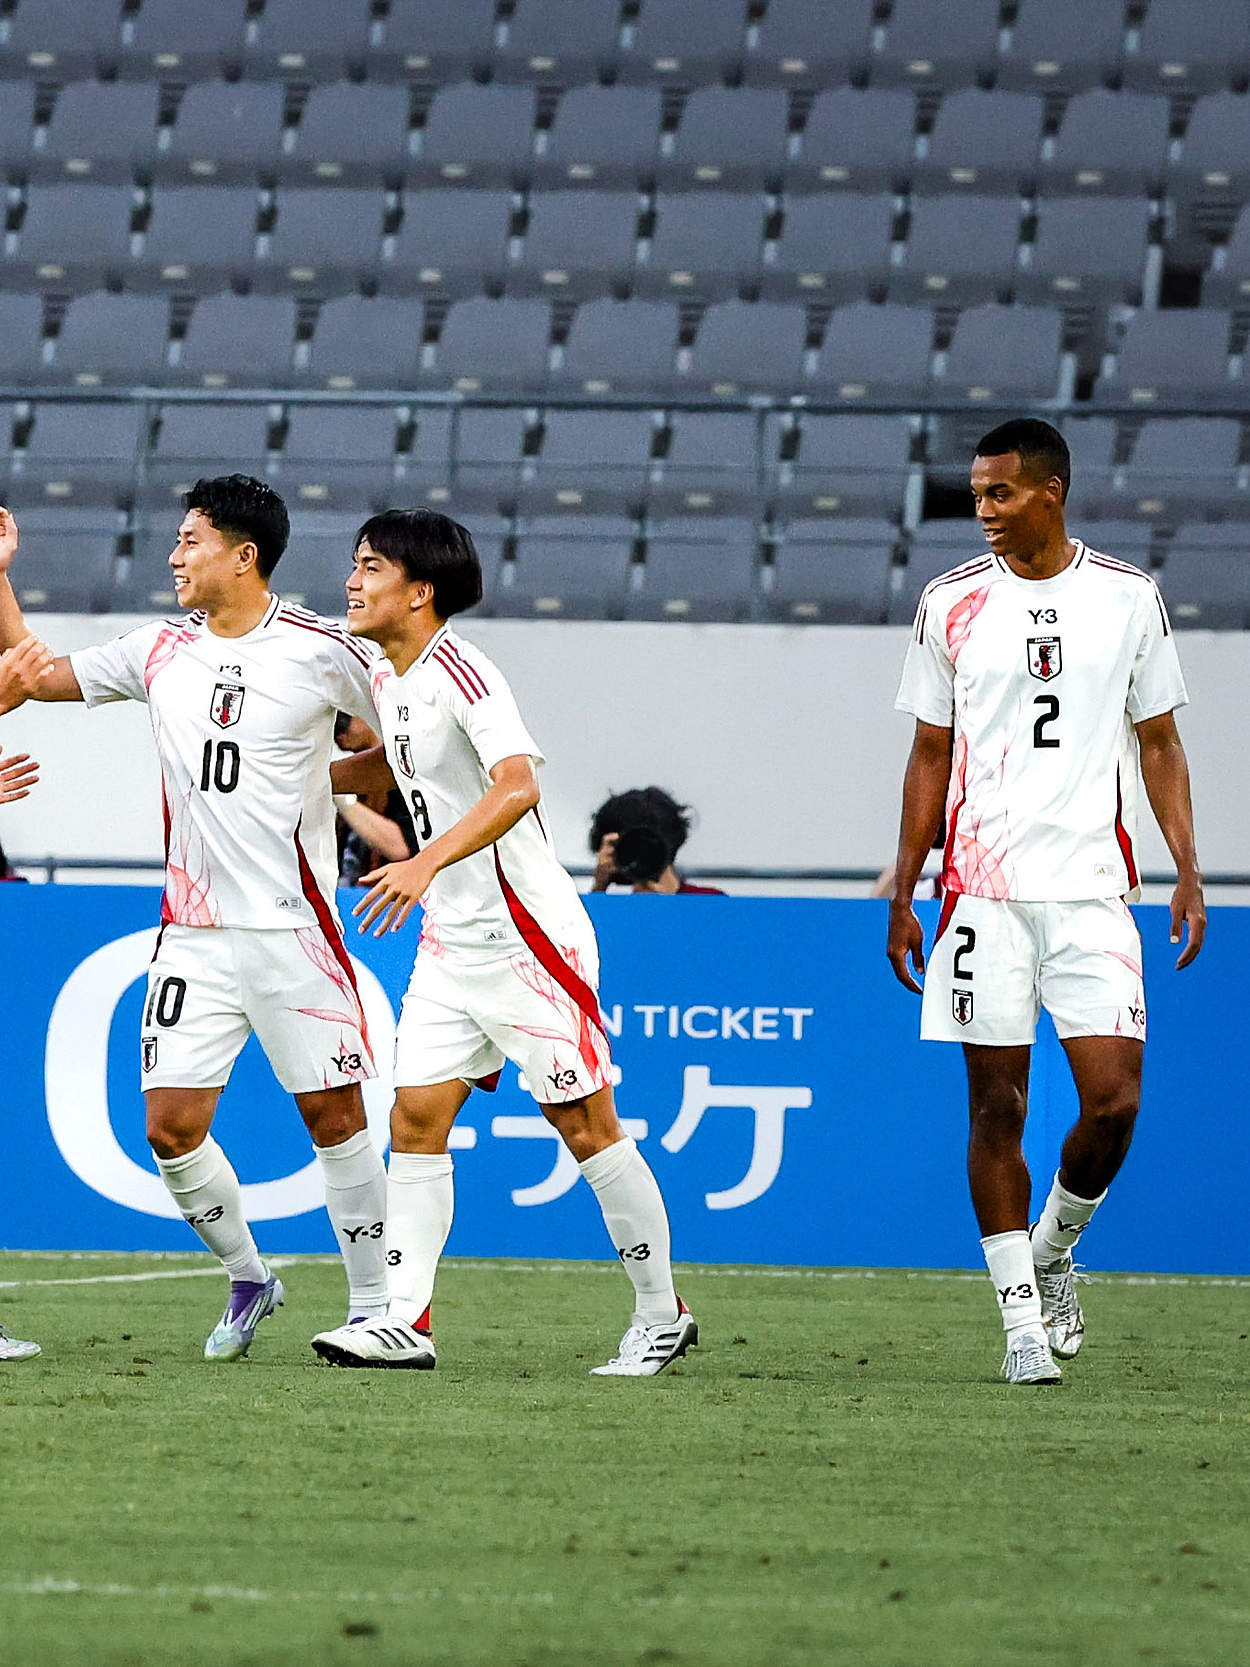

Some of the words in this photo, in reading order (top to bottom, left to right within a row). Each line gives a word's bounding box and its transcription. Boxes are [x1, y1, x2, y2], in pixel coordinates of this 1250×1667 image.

[1027, 608, 1058, 625] Y-3
[1033, 694, 1060, 749] 2
[200, 738, 241, 794] 10
[410, 789, 433, 841] 8
[953, 926, 976, 981] 2
[145, 975, 187, 1028] 10
[633, 1004, 815, 1041] TICKET
[330, 1053, 362, 1072] Y-3
[547, 1069, 578, 1090] Y-3
[342, 1221, 384, 1244] Y-3
[998, 1283, 1034, 1304] Y-3
